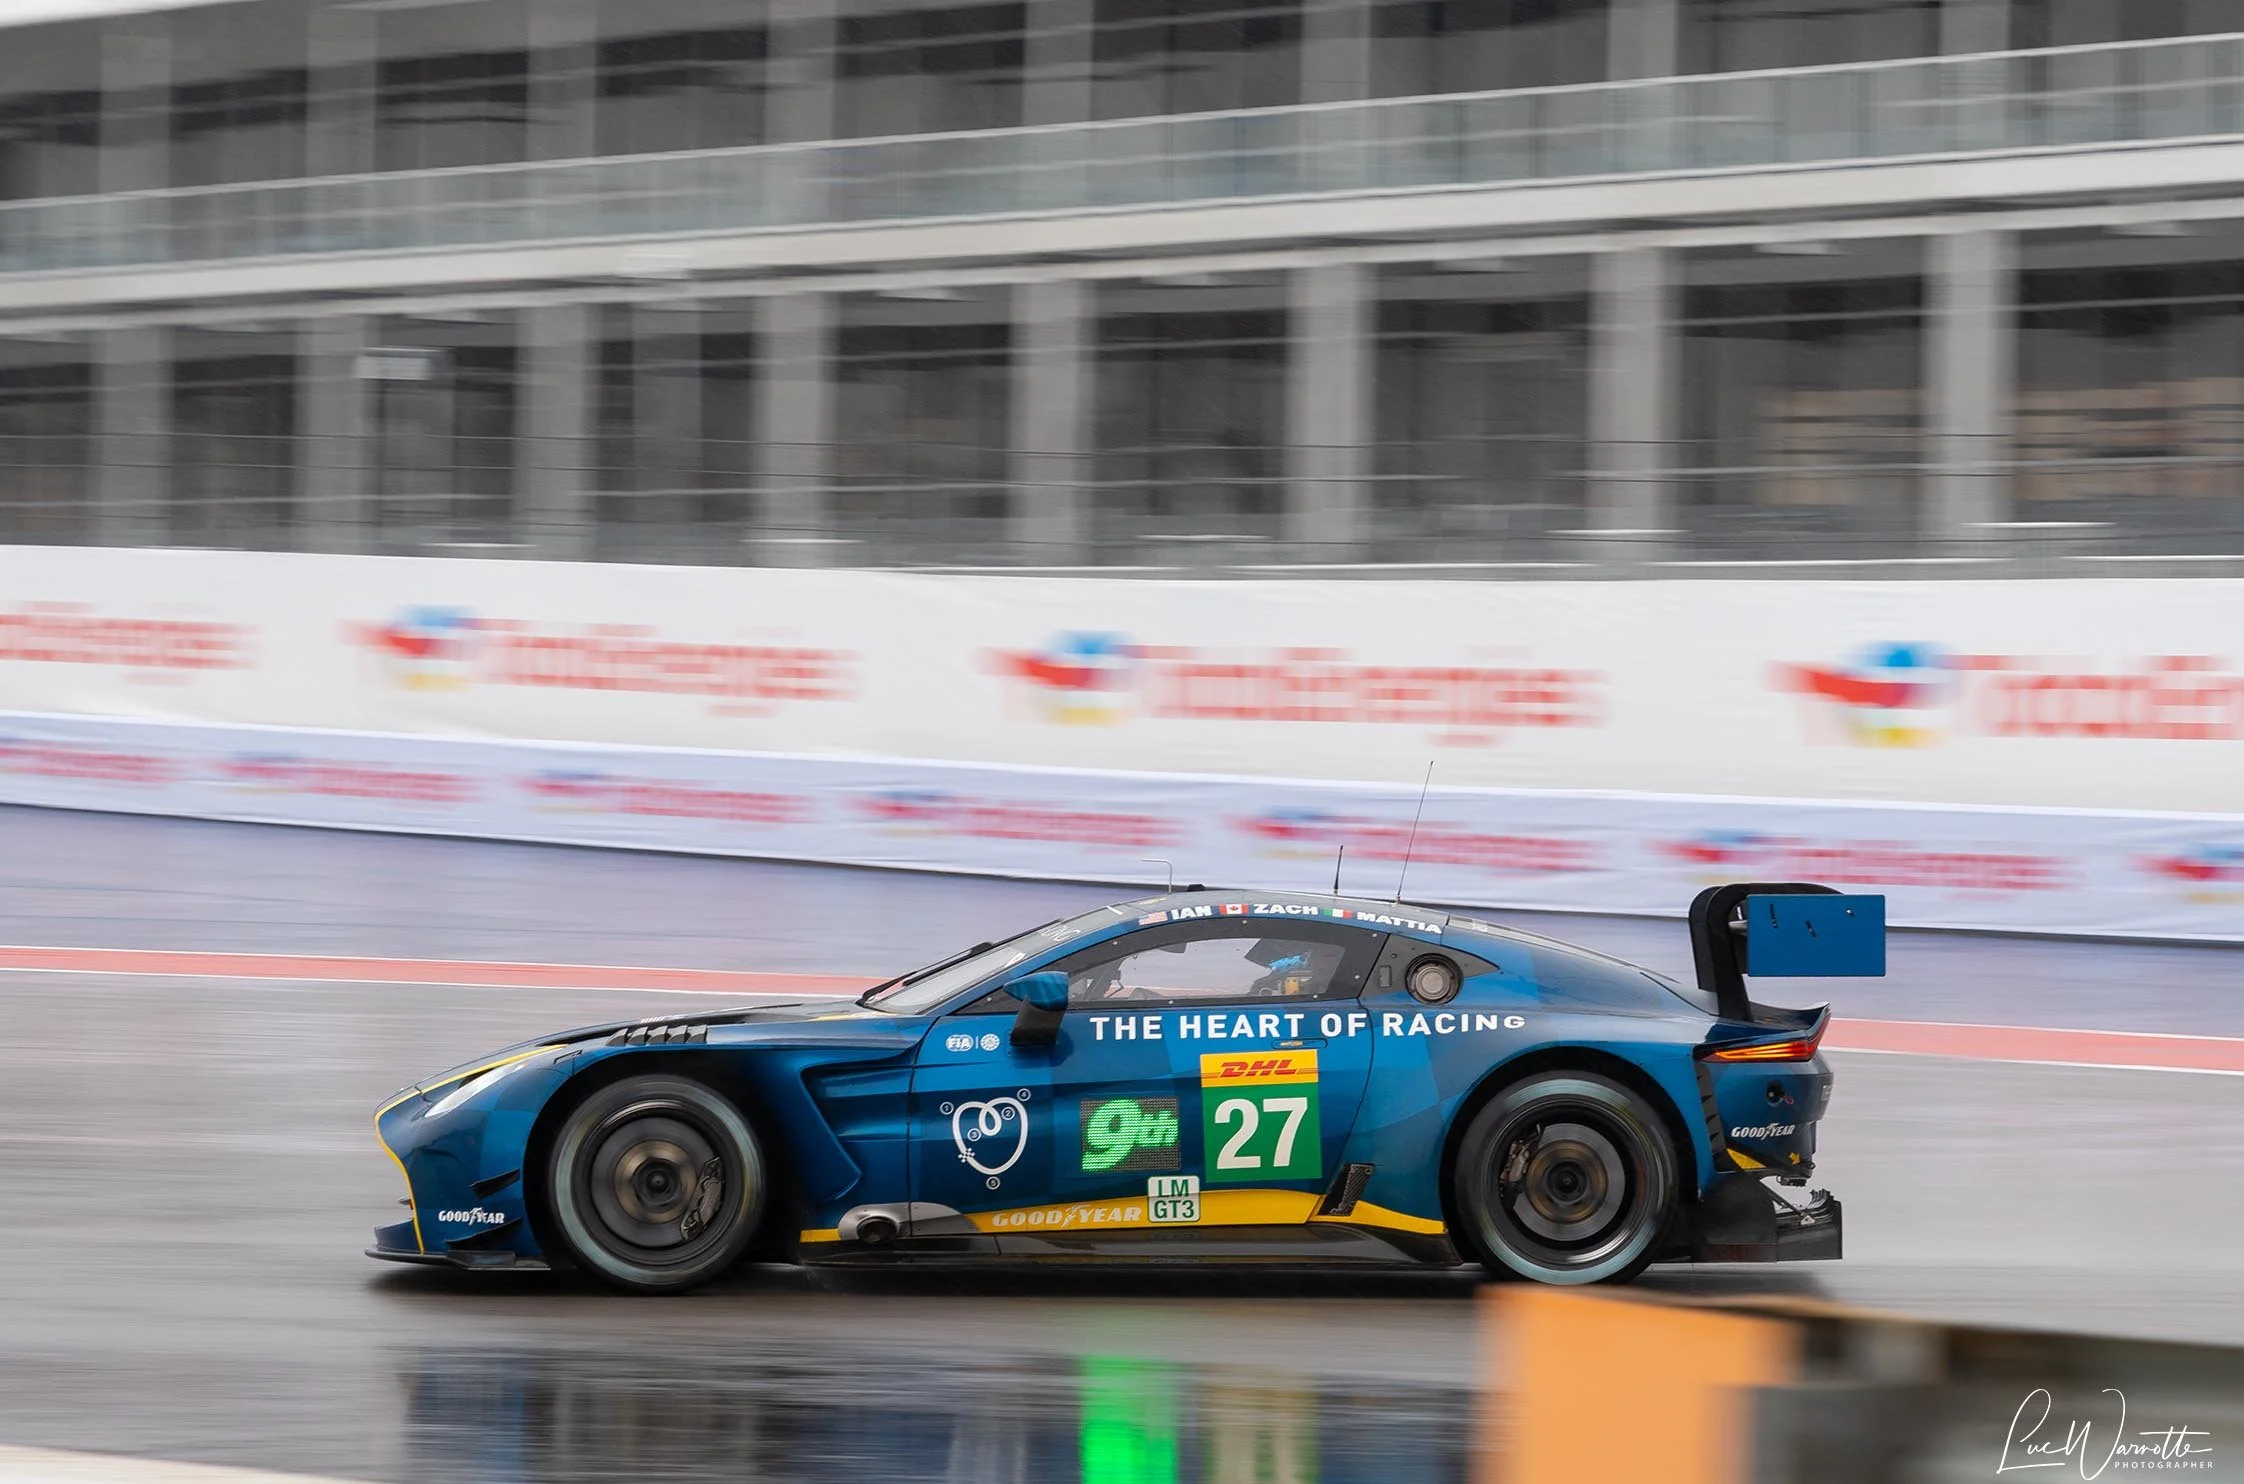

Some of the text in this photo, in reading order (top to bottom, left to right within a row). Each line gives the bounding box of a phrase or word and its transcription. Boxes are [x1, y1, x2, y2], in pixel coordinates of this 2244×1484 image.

[1170, 905, 1213, 920] IAN
[1253, 903, 1319, 916] ZACH
[1357, 911, 1443, 934] MATTIA
[1089, 1012, 1526, 1040] THE HEART OF RACING
[1220, 1058, 1299, 1078] DHL
[1081, 1099, 1179, 1171] 9th
[1214, 1097, 1309, 1170] 27
[1731, 1123, 1795, 1141] GOODYEAR
[1157, 1179, 1190, 1197] LM
[438, 1207, 505, 1226] GOODYEAR
[992, 1203, 1142, 1227] GOODYEAR
[1153, 1200, 1195, 1219] GT3
